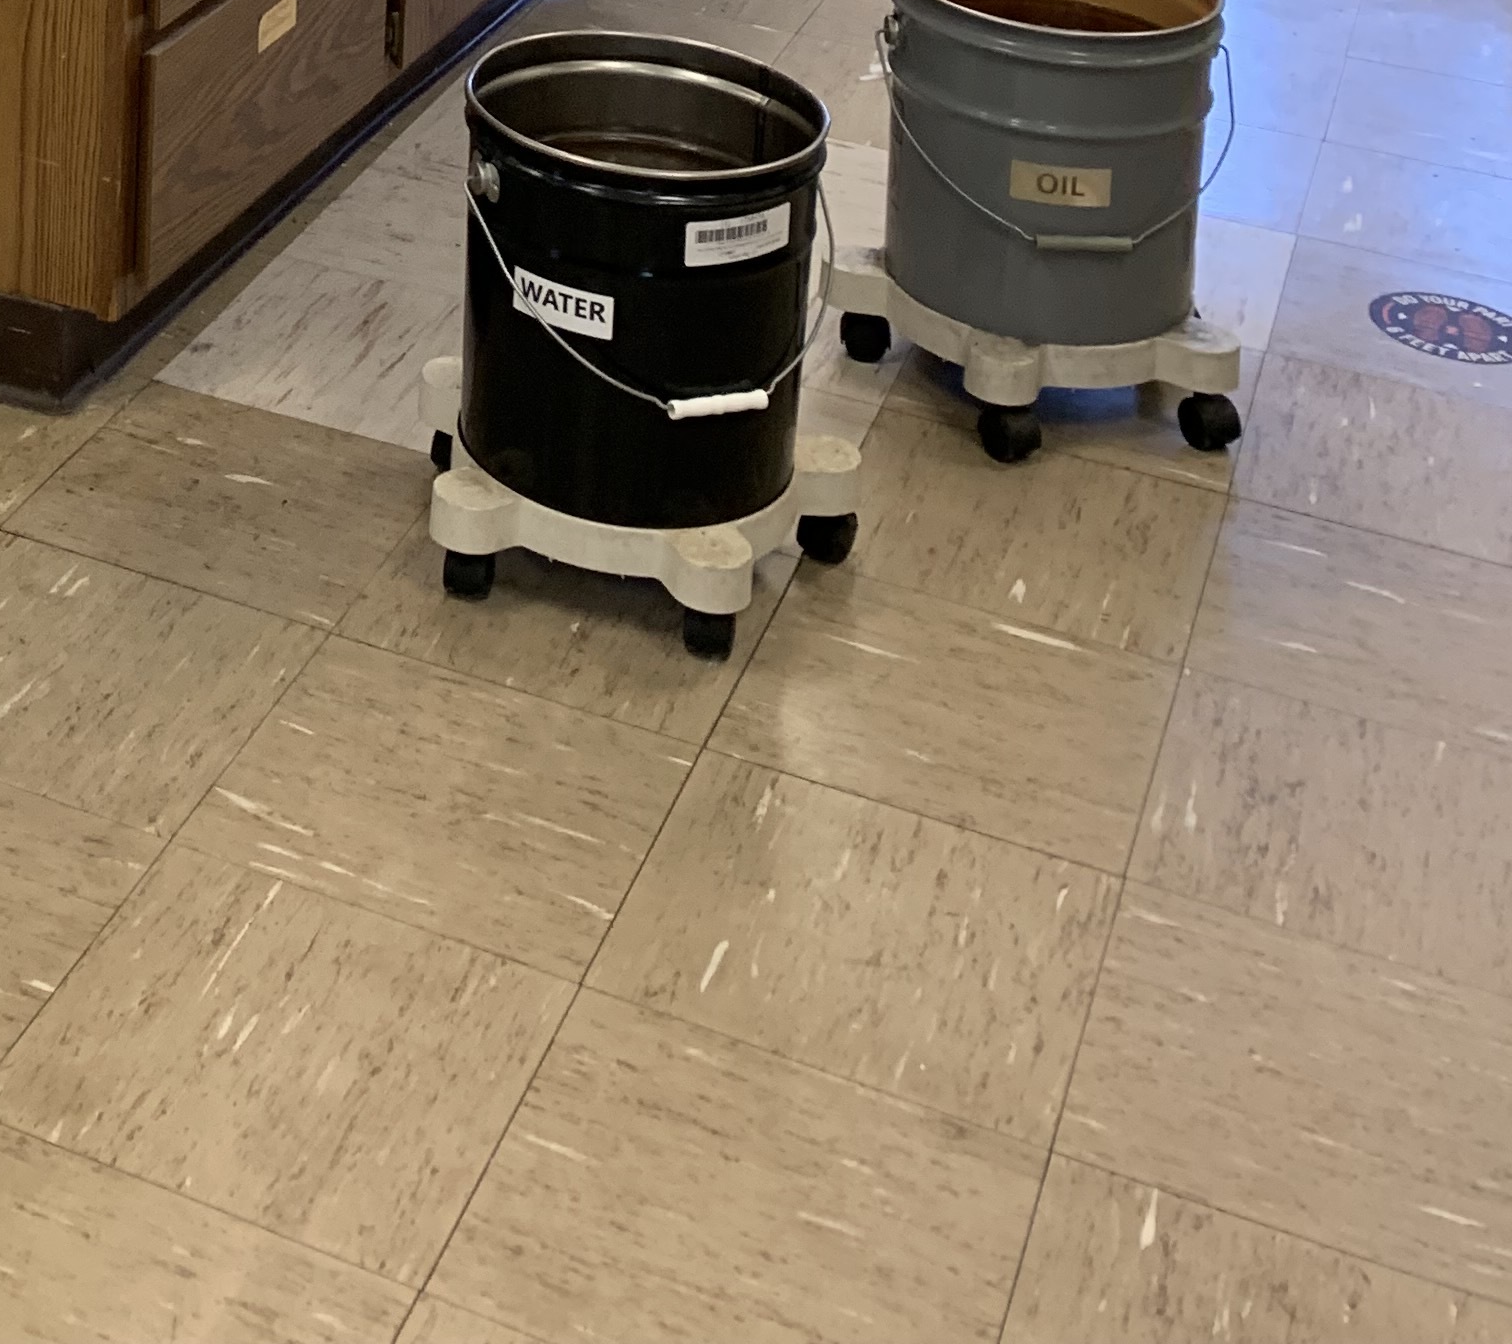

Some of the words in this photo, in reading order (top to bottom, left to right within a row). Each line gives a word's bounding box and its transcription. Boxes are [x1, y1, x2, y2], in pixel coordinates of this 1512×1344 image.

[1037, 173, 1085, 197] OIL
[521, 276, 606, 324] WATER
[1391, 294, 1419, 306] DO
[1418, 294, 1470, 310] YOUR
[1399, 334, 1451, 357] FEET
